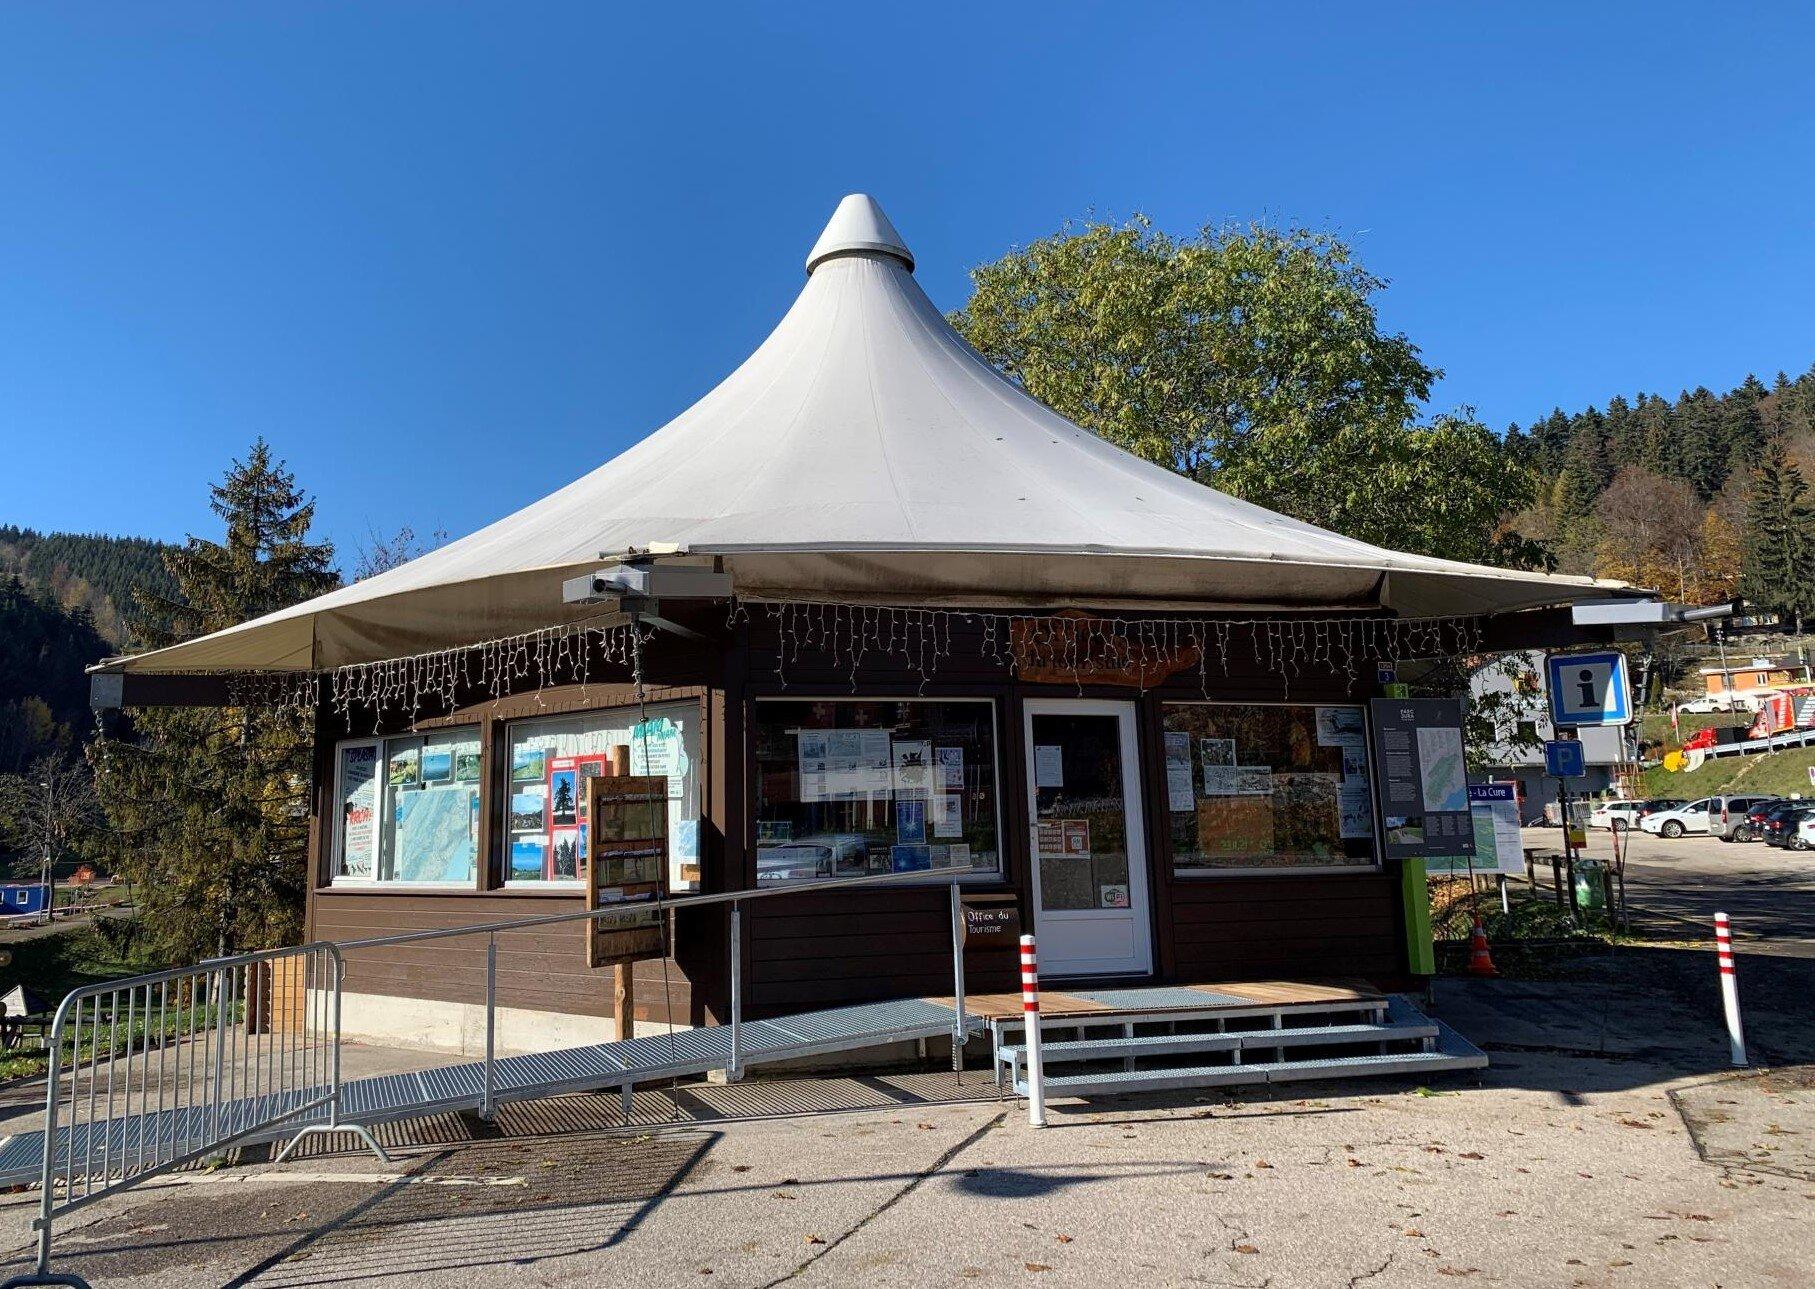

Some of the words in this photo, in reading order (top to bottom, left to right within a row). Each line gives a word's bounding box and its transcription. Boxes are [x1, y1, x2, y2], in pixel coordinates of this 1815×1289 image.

[1557, 747, 1573, 772] P
[1477, 788, 1487, 797] La
[1488, 788, 1506, 797] Cure
[967, 911, 993, 922] Office
[998, 909, 1009, 920] du
[969, 924, 1002, 934] Tourisme
